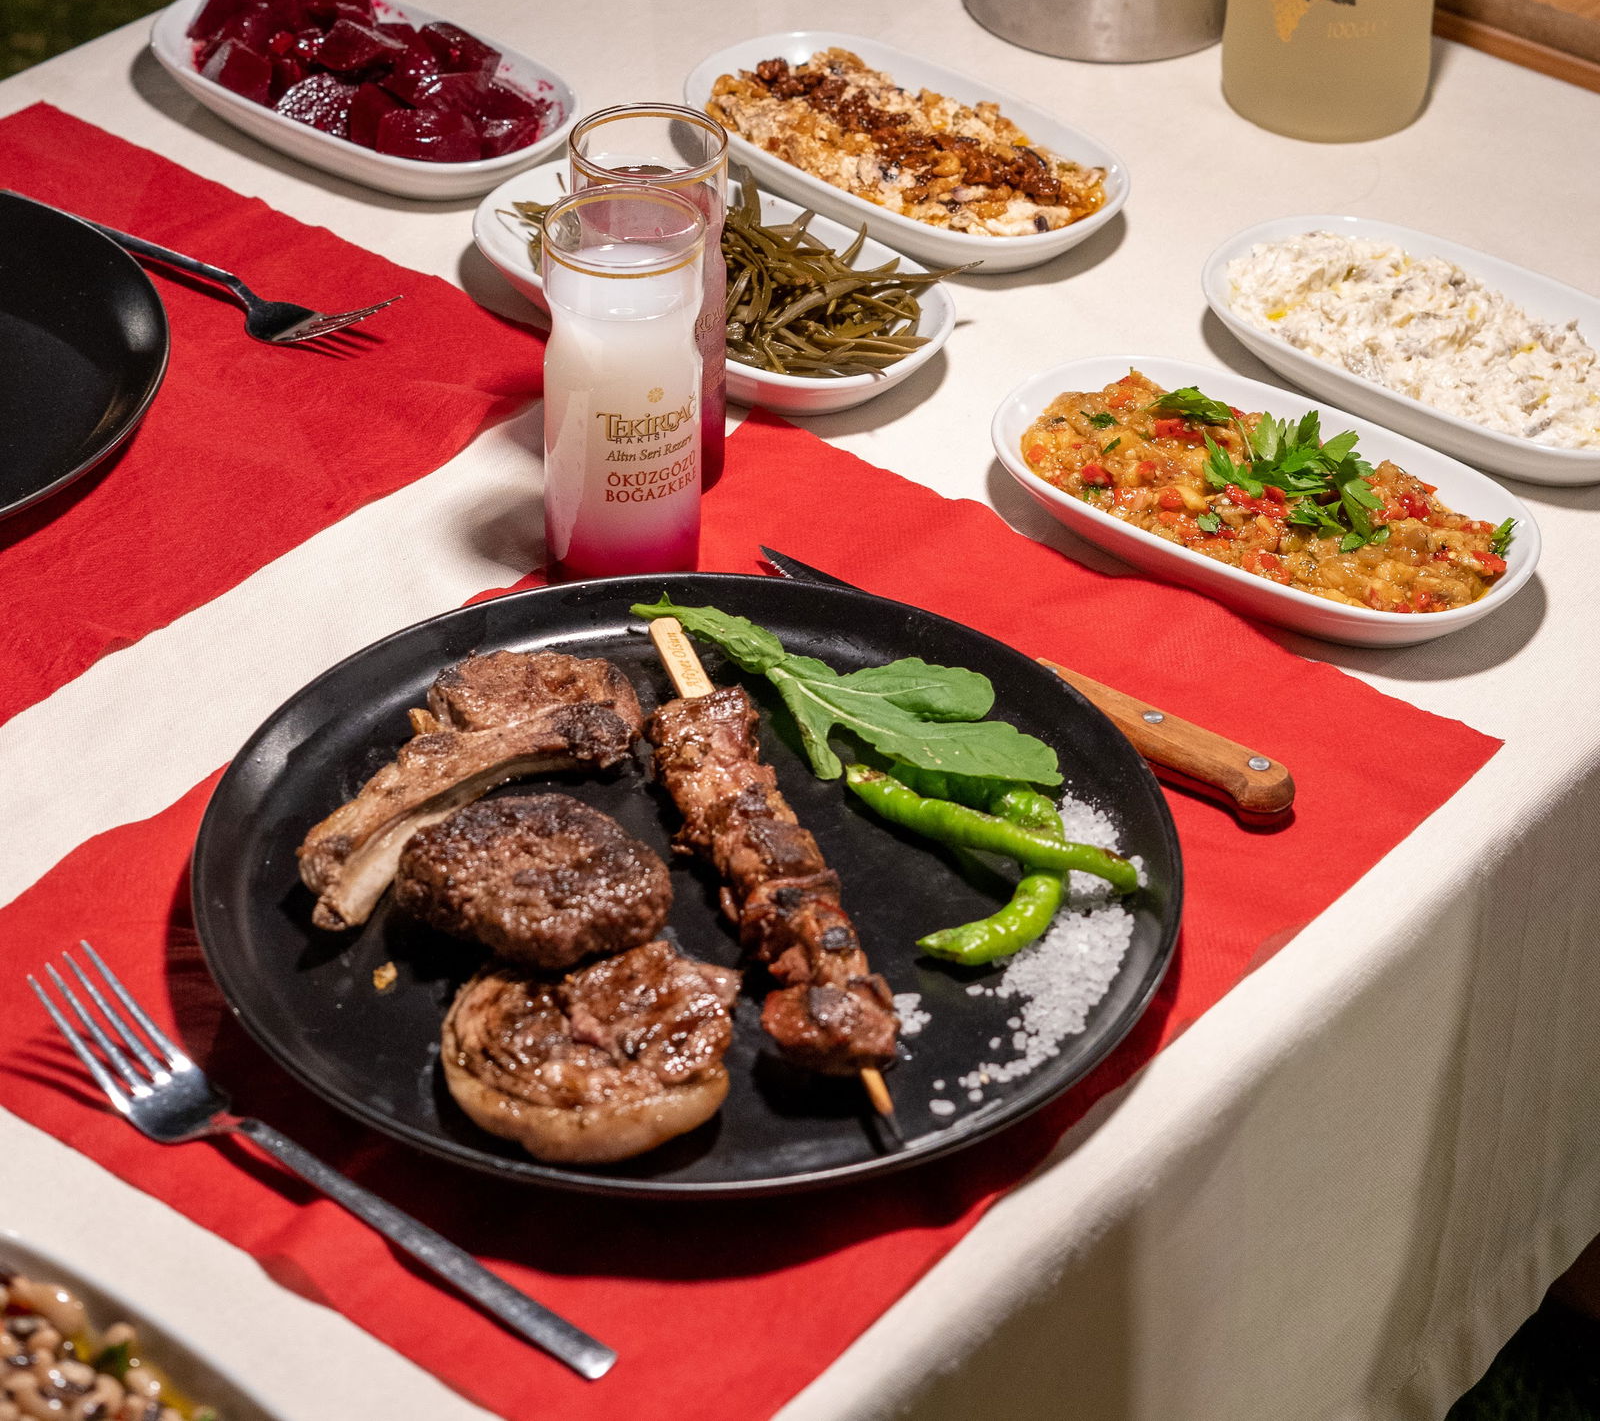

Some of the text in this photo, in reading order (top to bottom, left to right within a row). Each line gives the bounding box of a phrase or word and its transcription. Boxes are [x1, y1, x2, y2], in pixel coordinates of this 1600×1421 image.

[596, 391, 697, 442] TEKİRDAĞ
[615, 432, 667, 445] RAKISI
[605, 449, 637, 463] Altın
[639, 446, 662, 462] Seri
